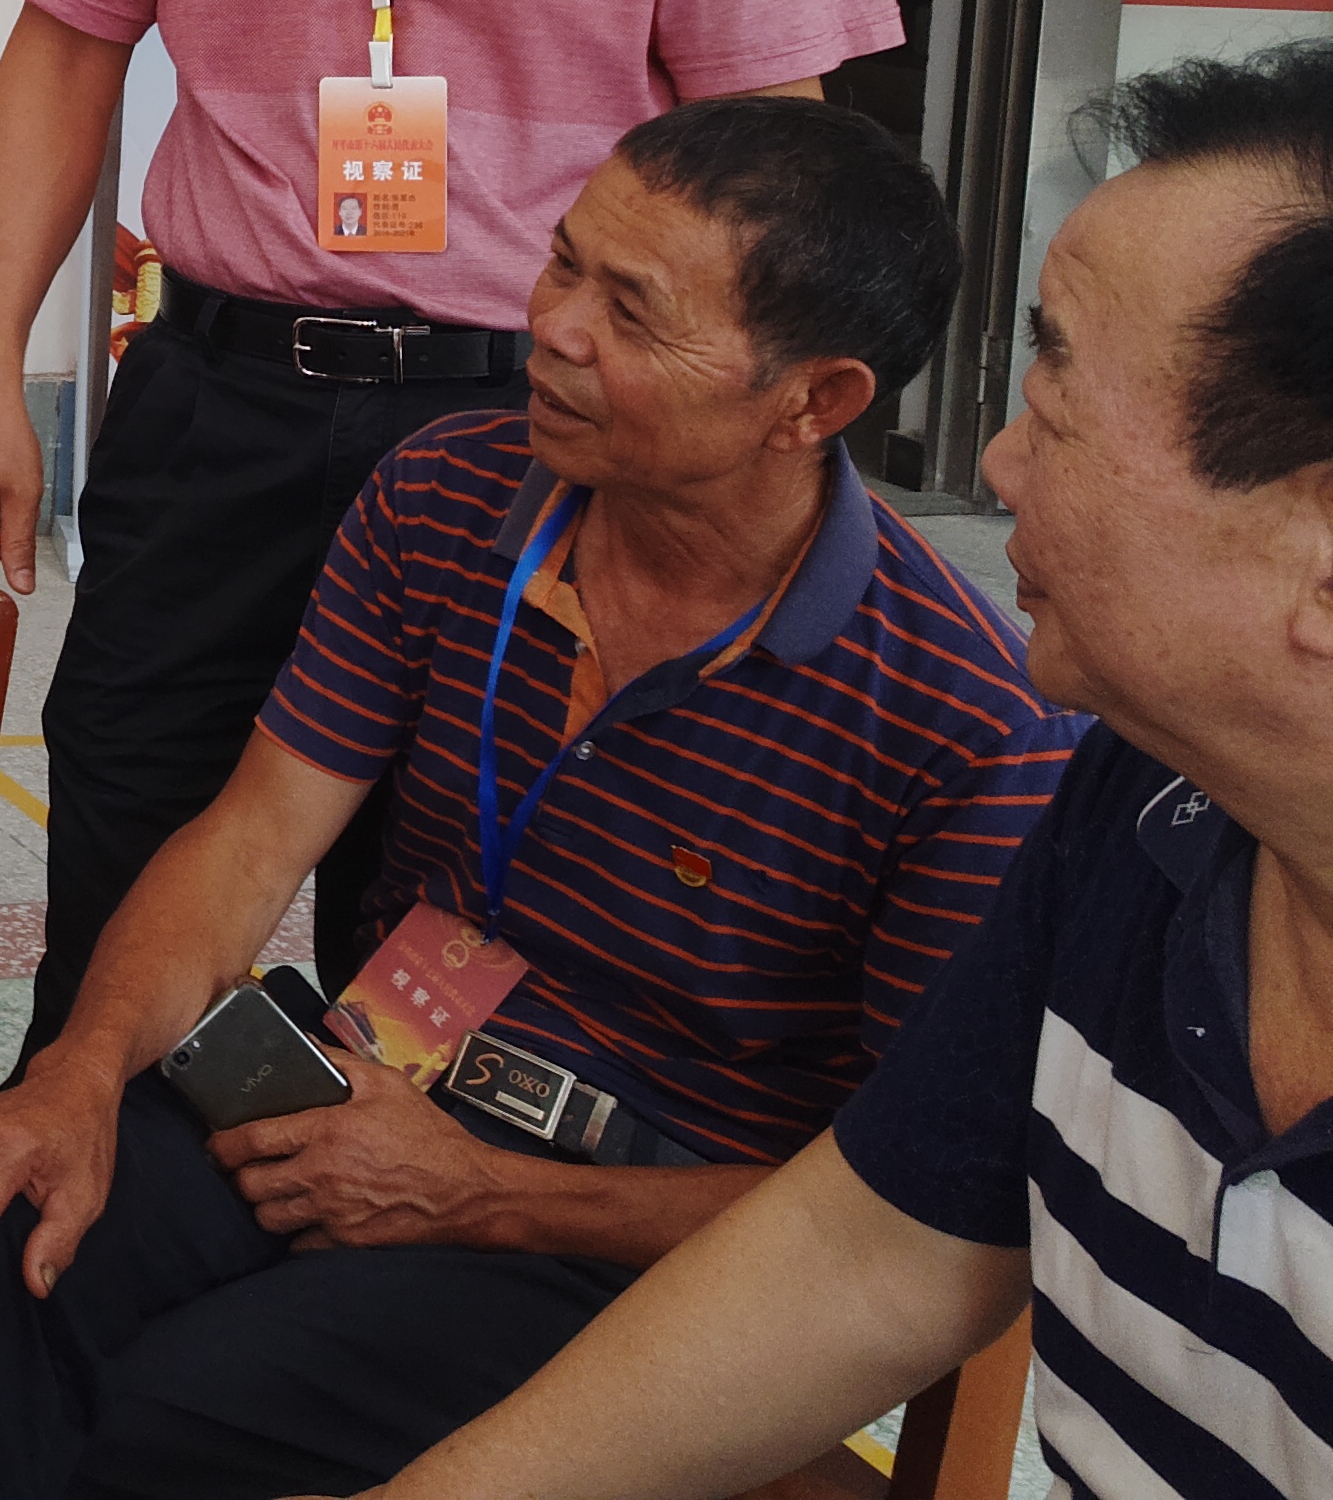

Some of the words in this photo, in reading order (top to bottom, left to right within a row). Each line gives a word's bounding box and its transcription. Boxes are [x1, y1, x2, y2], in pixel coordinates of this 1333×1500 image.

[343, 160, 423, 181] 视察证
[391, 968, 452, 1028] 视察证
